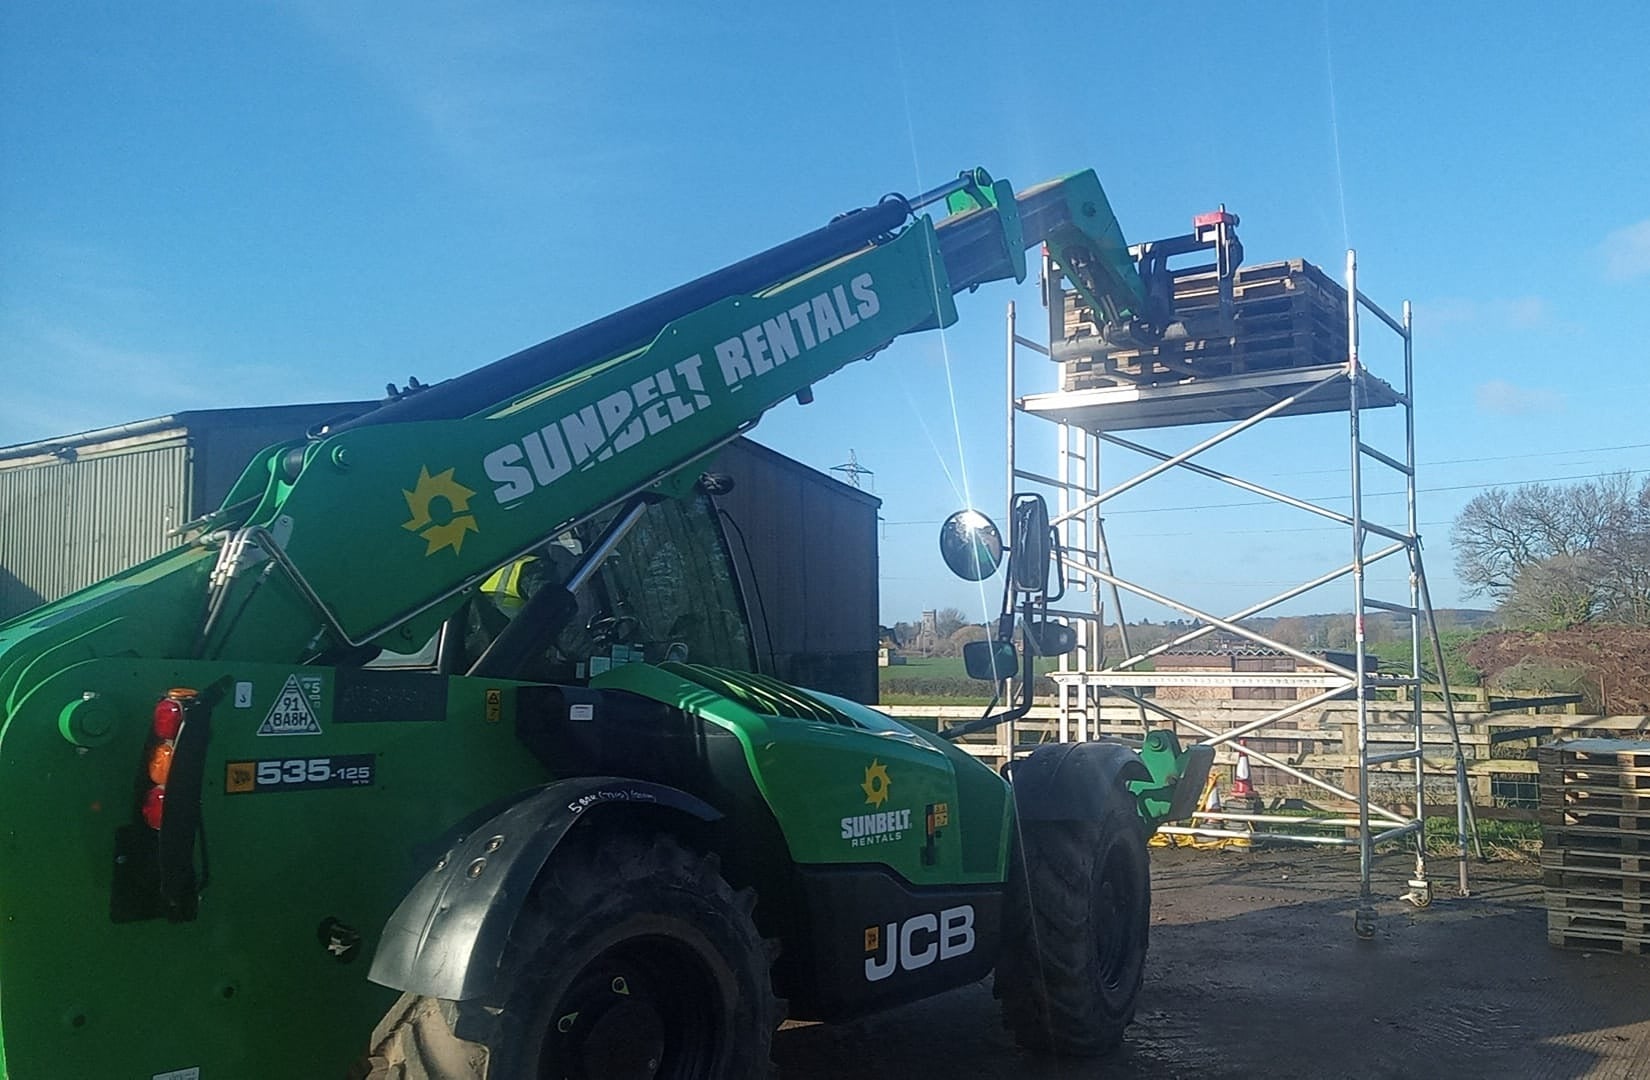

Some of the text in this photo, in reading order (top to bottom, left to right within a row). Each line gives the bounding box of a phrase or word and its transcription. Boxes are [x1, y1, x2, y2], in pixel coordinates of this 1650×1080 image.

[484, 272, 880, 504] SUNBELT RENTALS
[283, 697, 299, 711] 91
[256, 758, 370, 785] 535-125
[841, 808, 911, 839] SUNBELT
[851, 831, 902, 848] RENTALS
[865, 905, 976, 982] JCB
